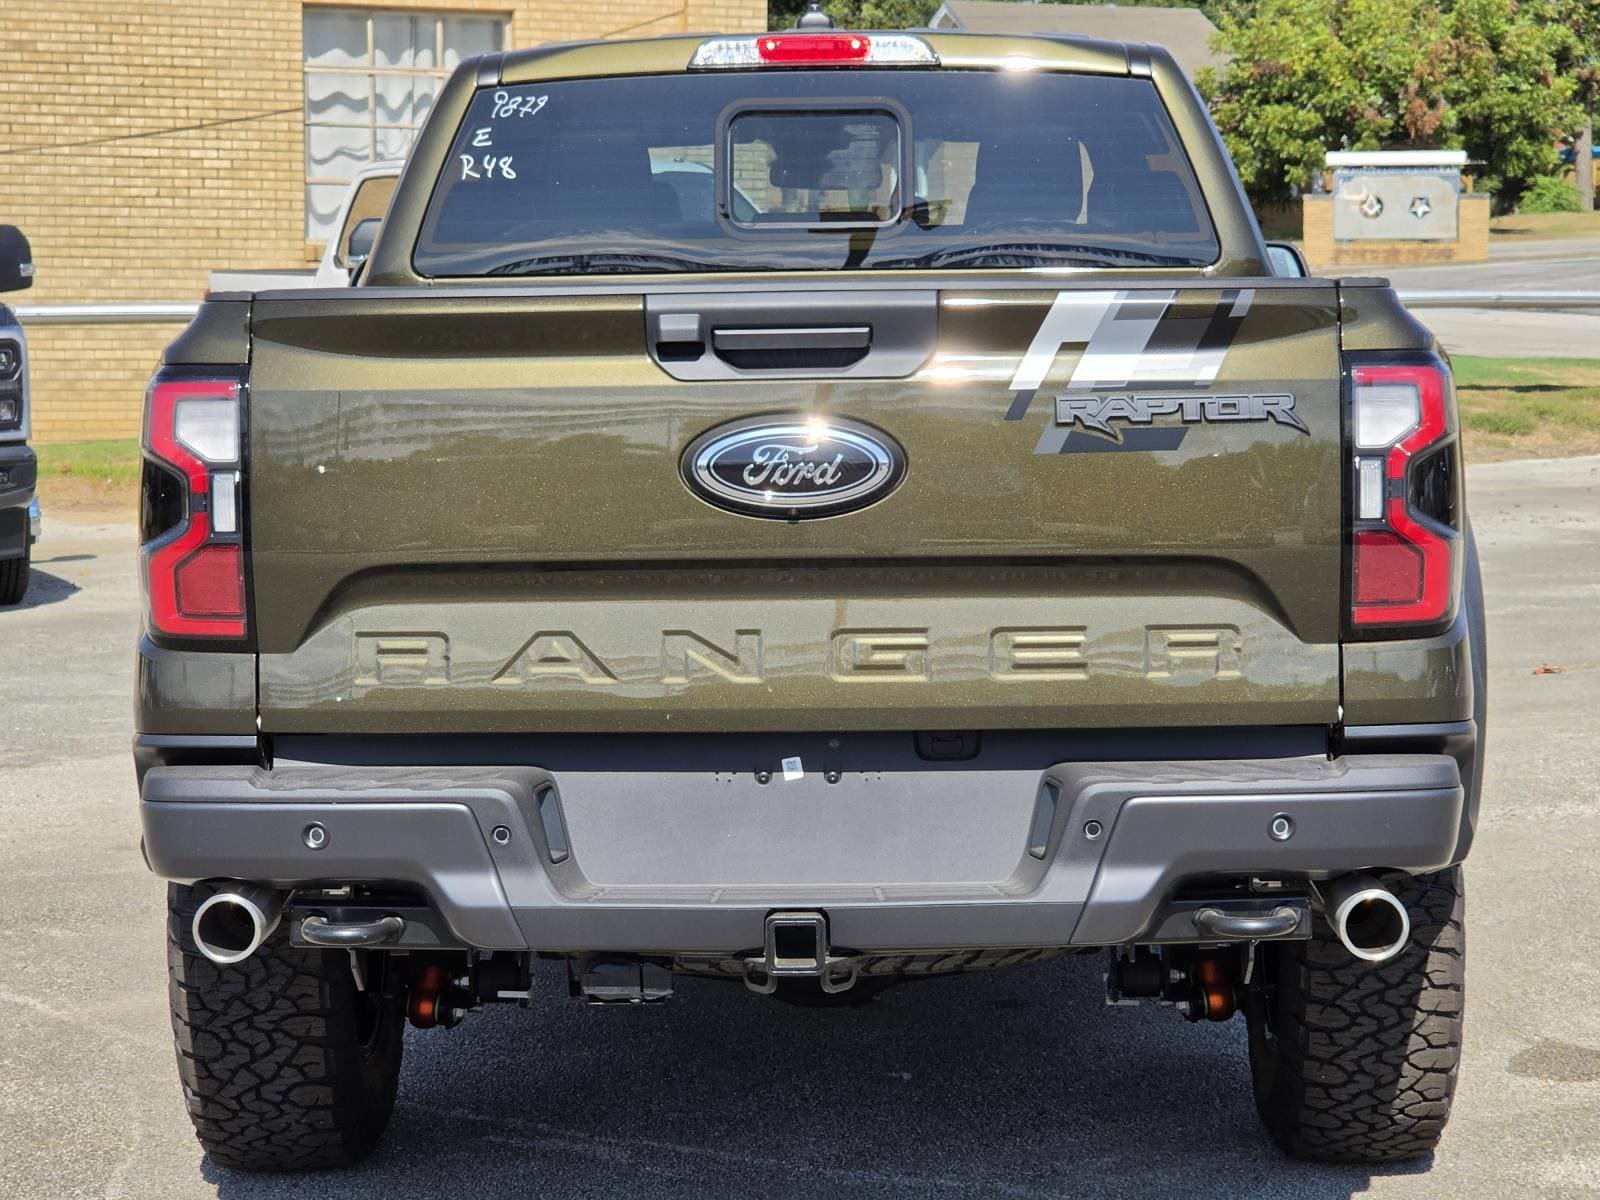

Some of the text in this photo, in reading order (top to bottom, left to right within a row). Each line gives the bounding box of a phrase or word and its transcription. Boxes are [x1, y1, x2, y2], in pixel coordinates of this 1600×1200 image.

[491, 90, 549, 118] 9879
[472, 127, 492, 147] E
[1054, 392, 1311, 441] RAPTOR
[742, 443, 843, 486] Ford
[352, 624, 1243, 685] RANGER
